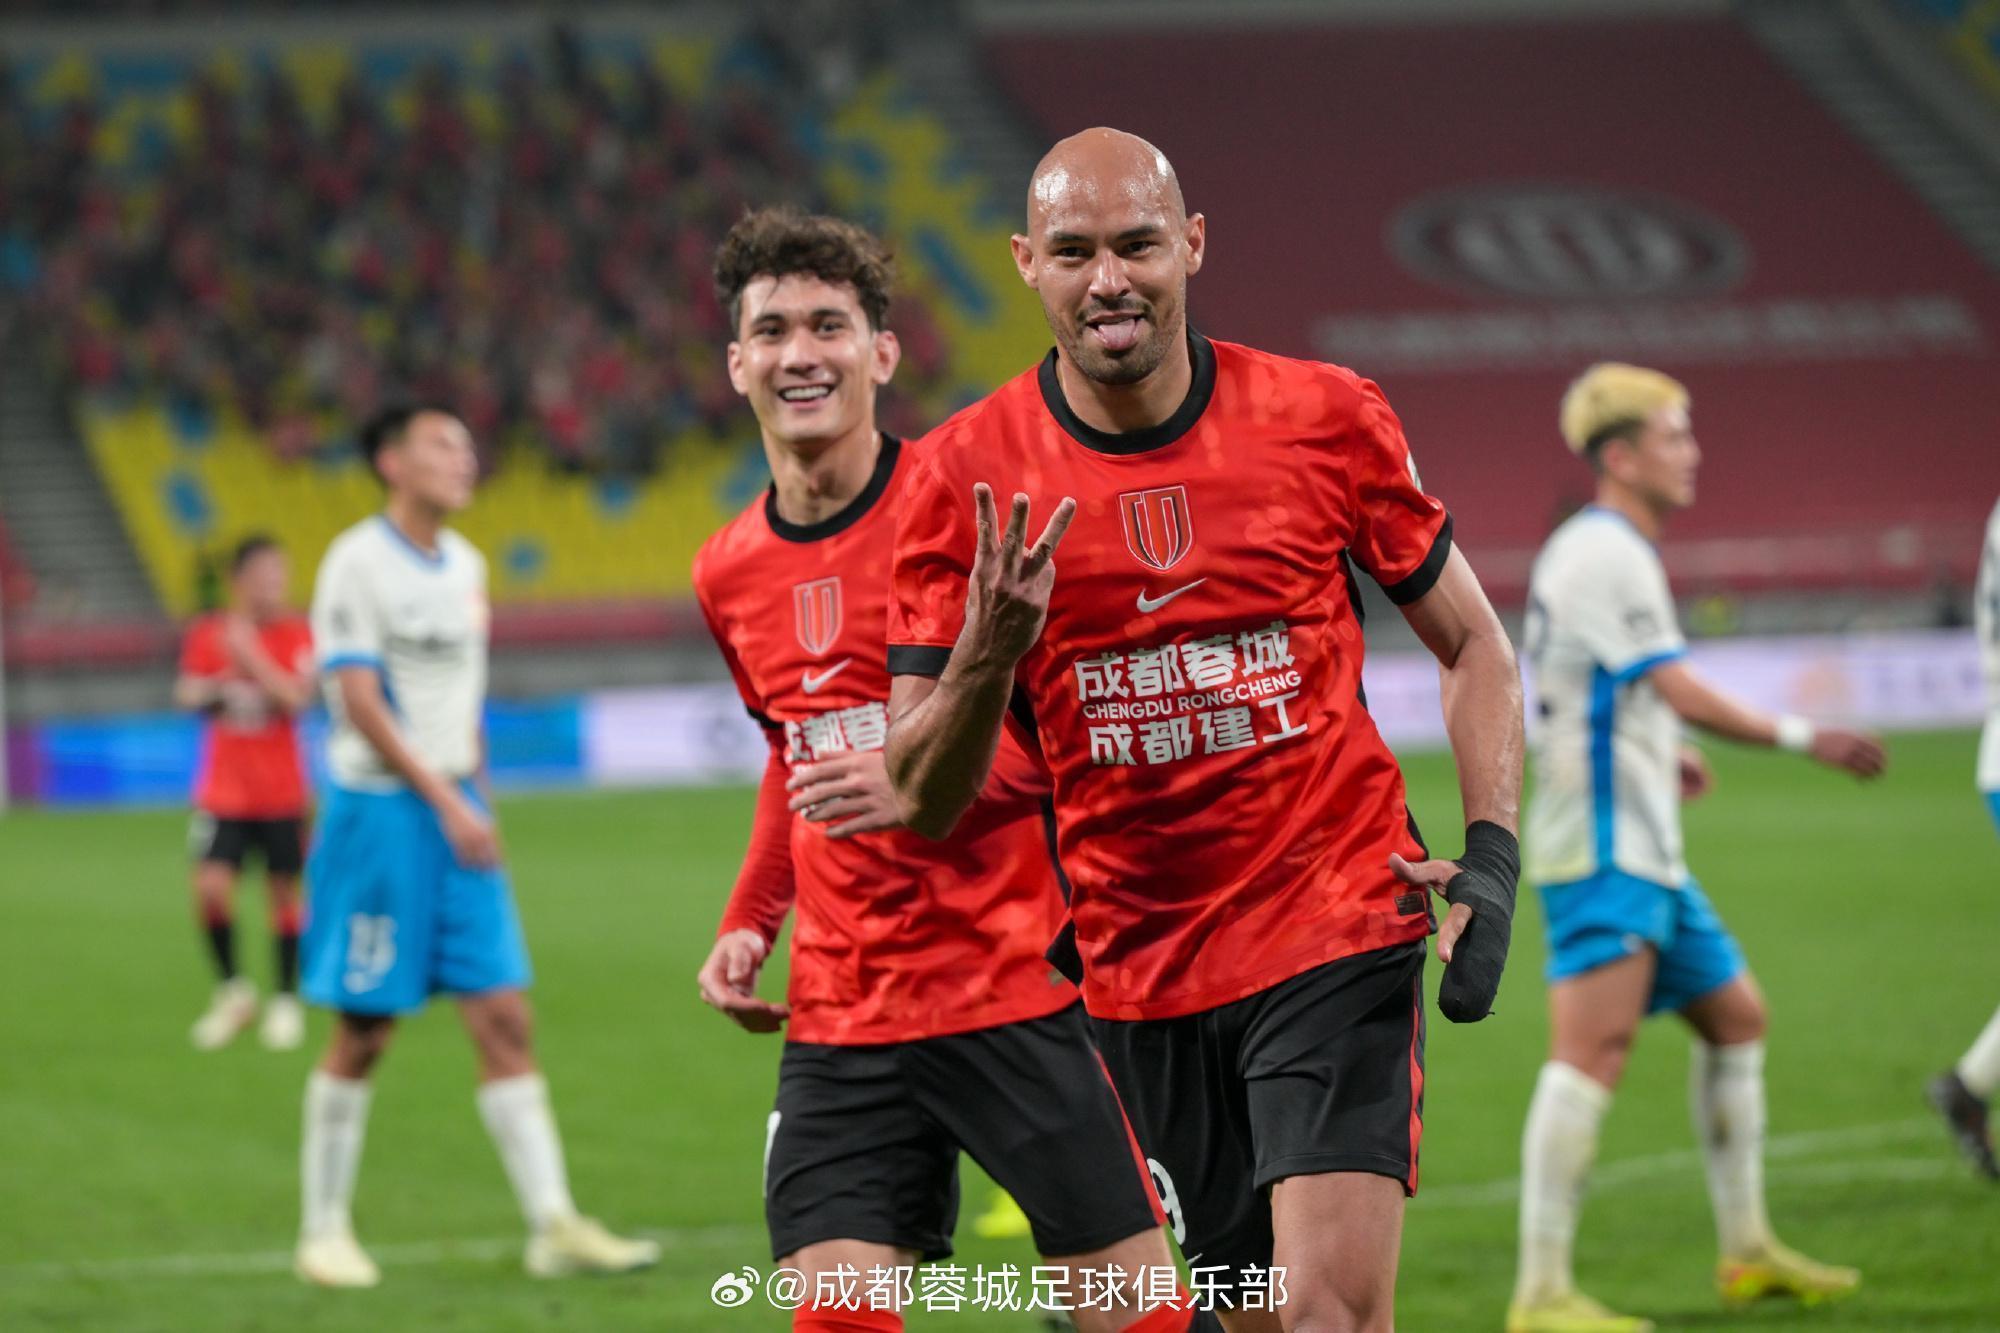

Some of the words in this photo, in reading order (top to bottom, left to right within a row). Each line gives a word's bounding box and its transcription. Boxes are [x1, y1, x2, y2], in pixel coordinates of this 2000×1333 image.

[1074, 619, 1295, 702] 成都蓉城
[1082, 698, 1172, 720] CHENGDU
[1178, 671, 1302, 712] RONGCHENG
[1088, 690, 1308, 767] 成都建工
